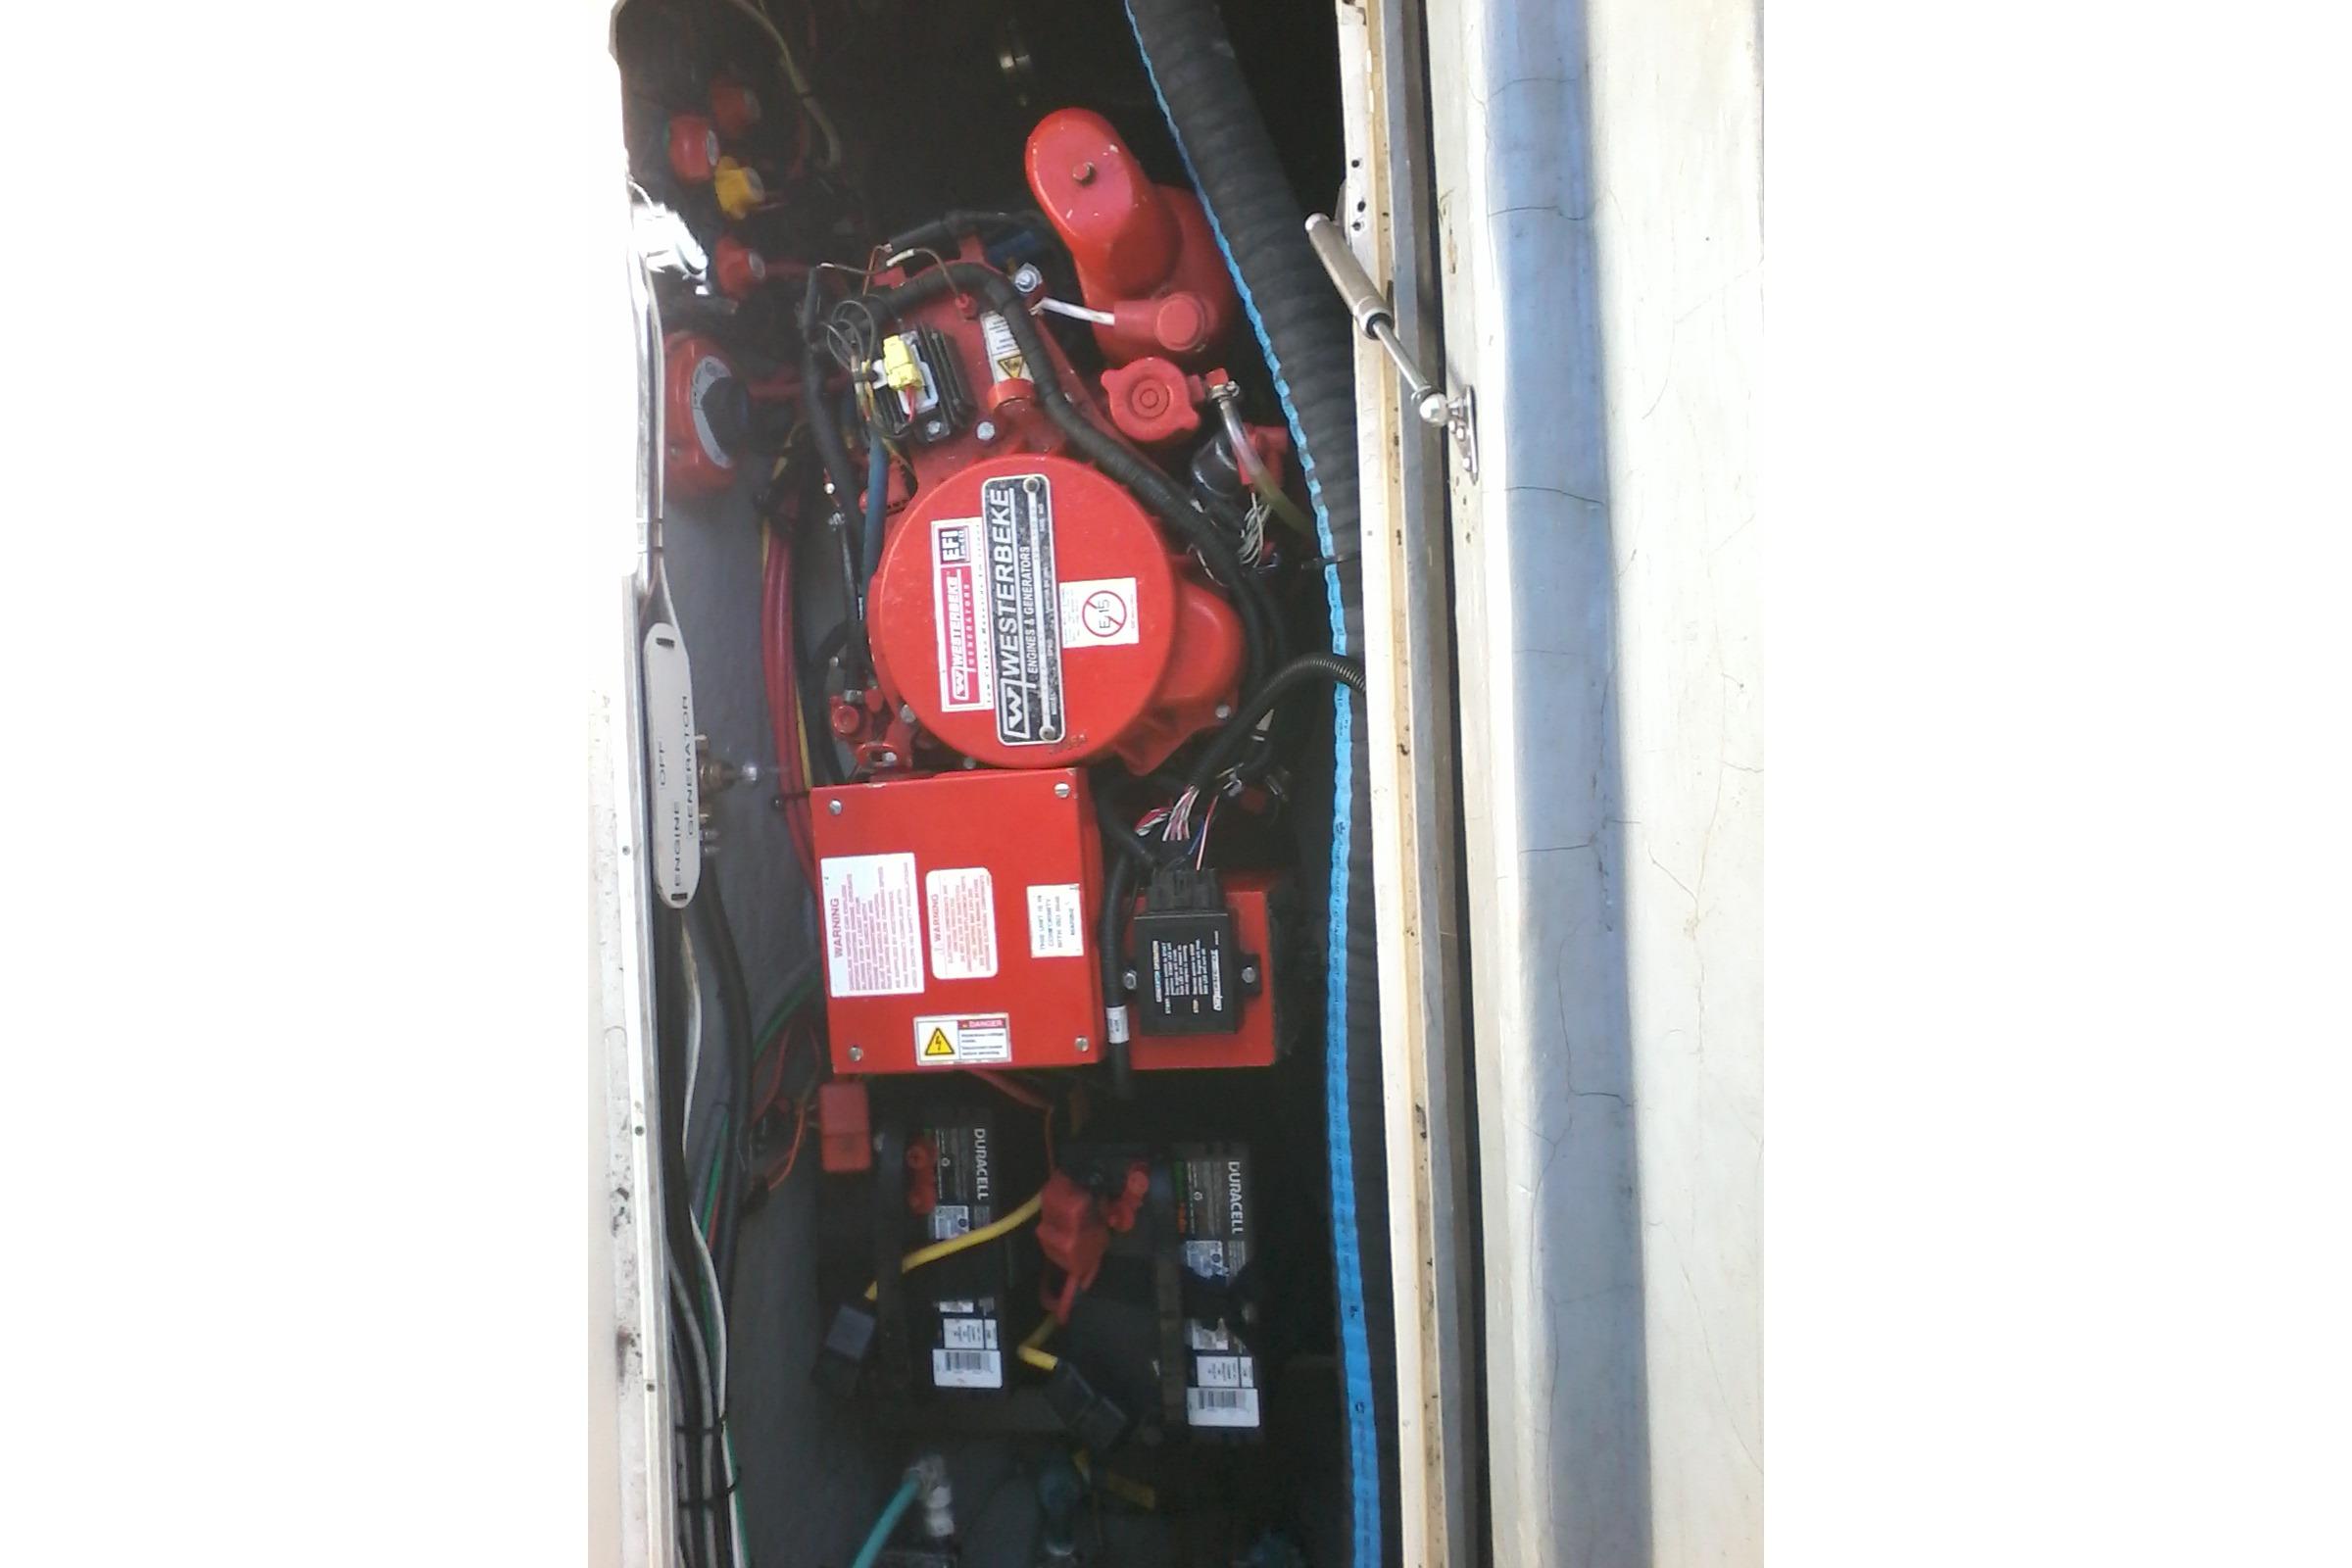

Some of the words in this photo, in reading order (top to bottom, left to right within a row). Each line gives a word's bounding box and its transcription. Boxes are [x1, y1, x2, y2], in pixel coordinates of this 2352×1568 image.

[941, 530, 959, 561] EFI
[990, 489, 1019, 676] WESTERBEKE
[1019, 547, 1035, 614] GENERATORS
[947, 577, 963, 666] WESTERBEKE
[963, 584, 974, 664] GENERATORS
[1026, 629, 1038, 673] ENGINES
[658, 740, 666, 786] OFF
[681, 695, 693, 835] GENERATOR
[672, 801, 681, 887] ENGINE
[830, 899, 843, 958] WARNING
[931, 894, 941, 942] WARNING
[973, 1127, 990, 1201] DURACELL
[1228, 1160, 1245, 1235] DURACELL
